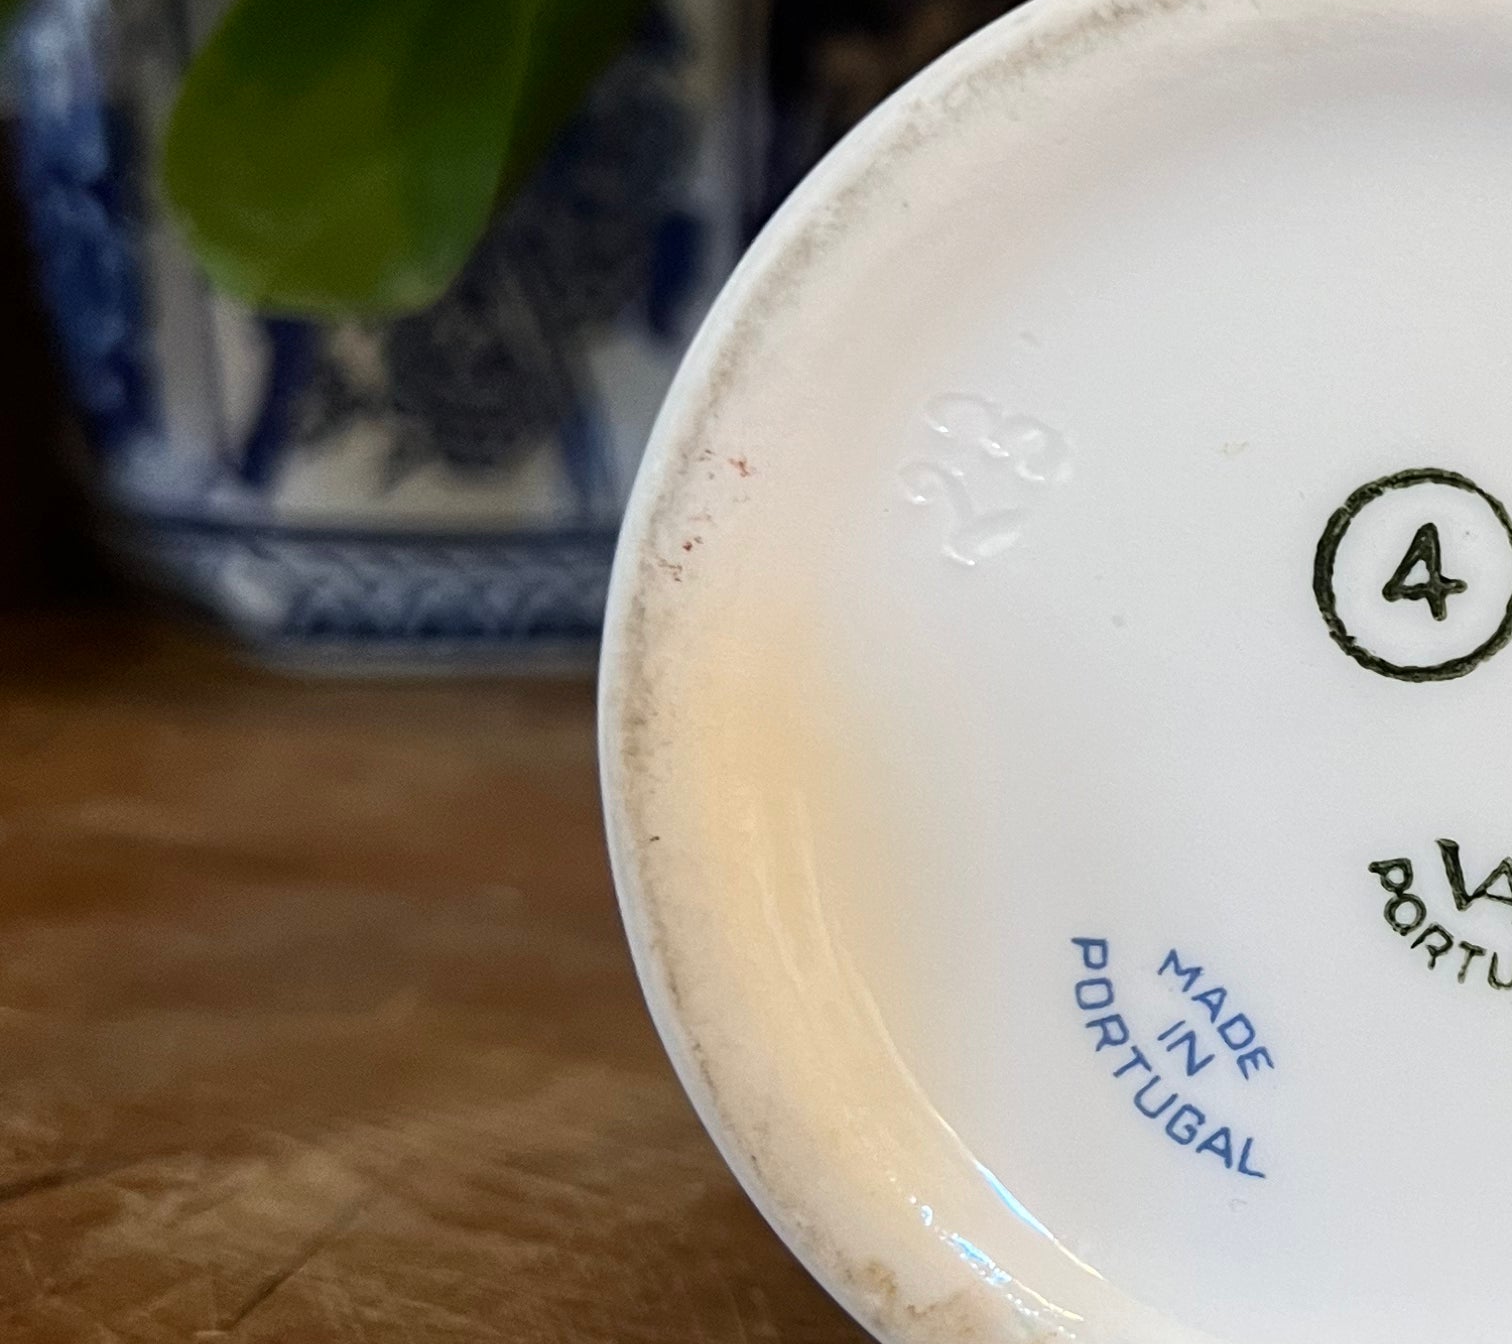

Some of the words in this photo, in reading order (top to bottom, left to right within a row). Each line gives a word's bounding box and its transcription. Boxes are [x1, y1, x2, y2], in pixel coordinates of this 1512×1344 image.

[1382, 522, 1468, 622] 4
[1072, 936, 1266, 1180] PORTUGAL
[1156, 1020, 1215, 1077] IN
[1157, 948, 1275, 1081] MADE
